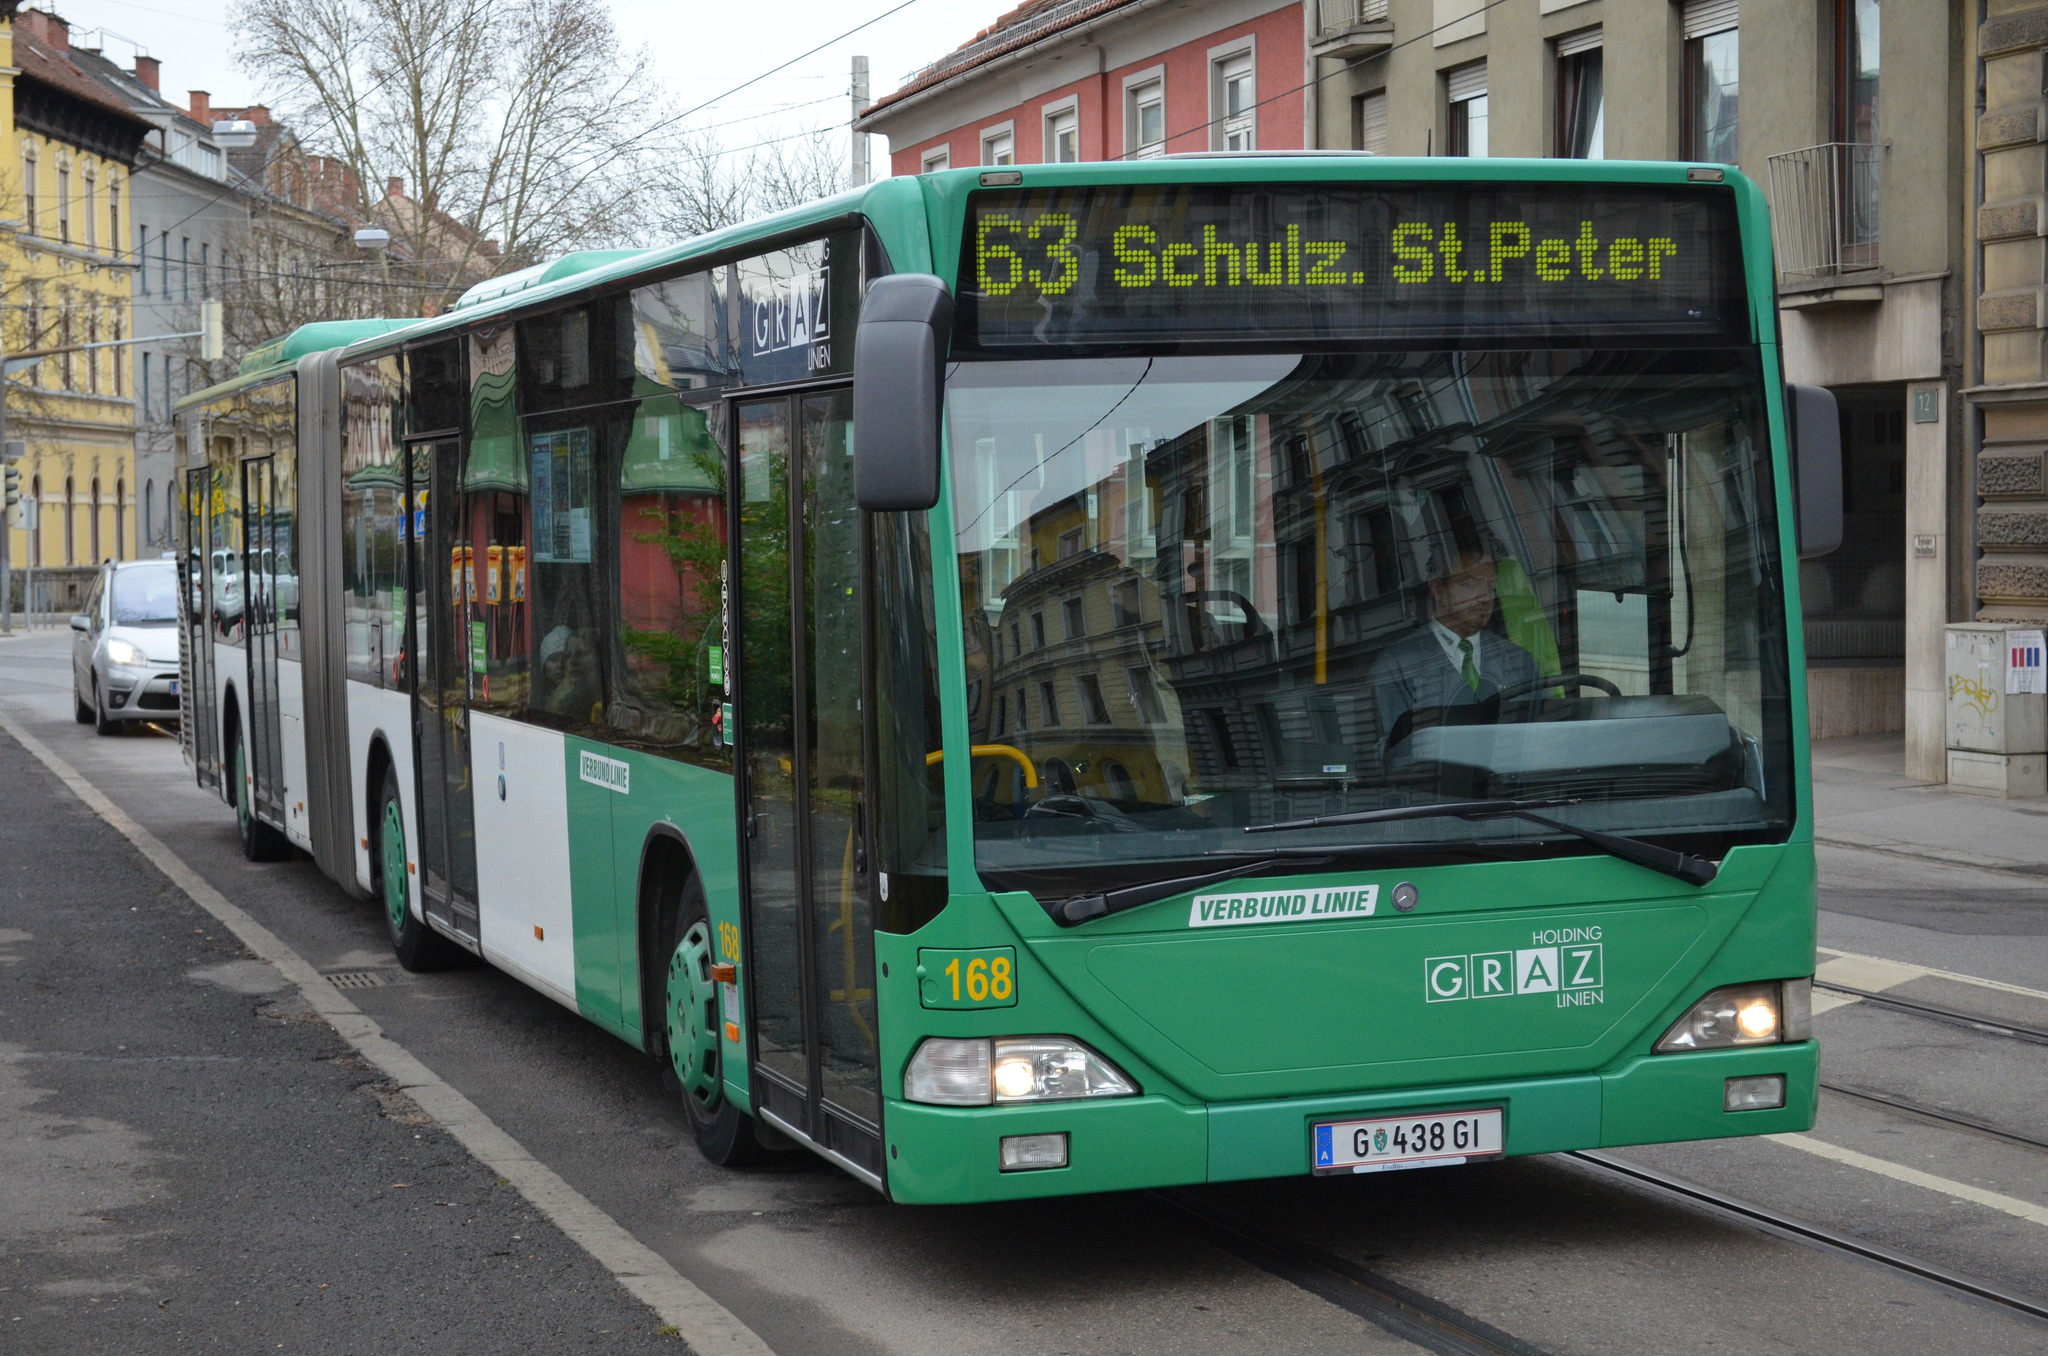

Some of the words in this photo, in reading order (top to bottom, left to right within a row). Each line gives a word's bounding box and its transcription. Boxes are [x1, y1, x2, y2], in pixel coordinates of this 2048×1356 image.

[976, 213, 1077, 295] 63
[1113, 224, 1364, 287] Schulz.
[1392, 221, 1677, 283] St.Peter
[754, 273, 828, 351] GRAZ
[1918, 393, 1930, 411] 12
[581, 755, 610, 783] VERBUND
[610, 763, 627, 789] LINIE
[1200, 895, 1306, 921] VERBUND
[1311, 890, 1370, 914] LINIE
[719, 921, 739, 962] 168
[1533, 925, 1602, 945] HOLDING
[945, 956, 1013, 1001] 168
[1428, 946, 1600, 1000] GRAZ
[1557, 990, 1604, 1008] LINIEN
[1321, 1151, 1329, 1160] A
[1353, 1128, 1369, 1158] G
[1393, 1121, 1445, 1154] 438
